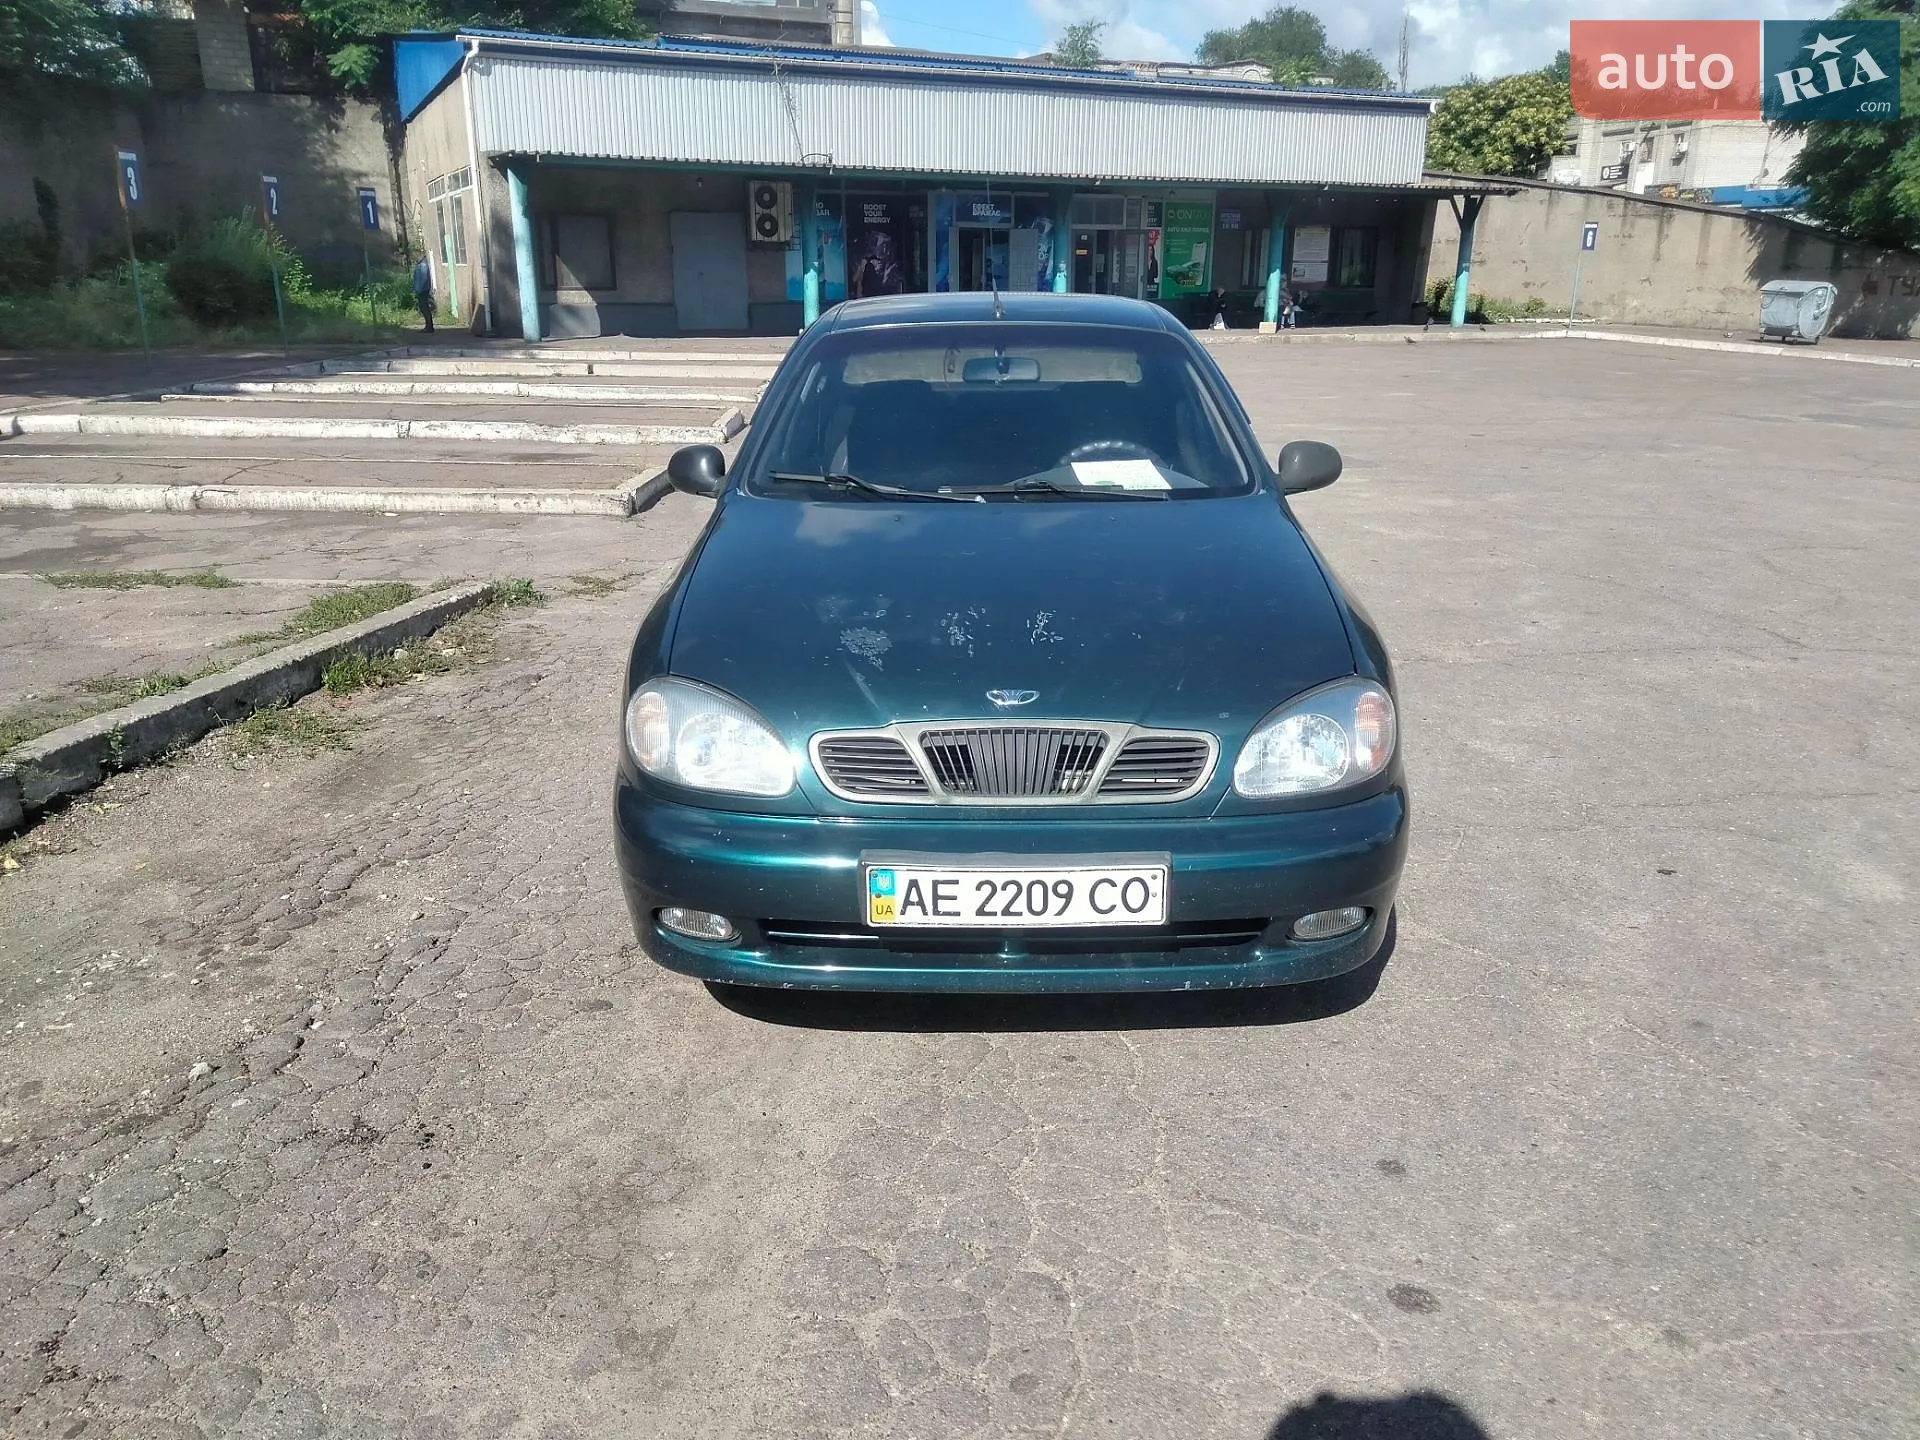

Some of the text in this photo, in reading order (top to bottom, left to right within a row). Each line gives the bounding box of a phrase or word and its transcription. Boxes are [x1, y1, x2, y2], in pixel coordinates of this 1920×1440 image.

[126, 166, 138, 200] 3
[270, 187, 278, 215] 2
[366, 200, 374, 224] 1
[1586, 230, 1593, 247] 6
[875, 904, 894, 915] UA
[900, 876, 1150, 917] AE 2209 CO
